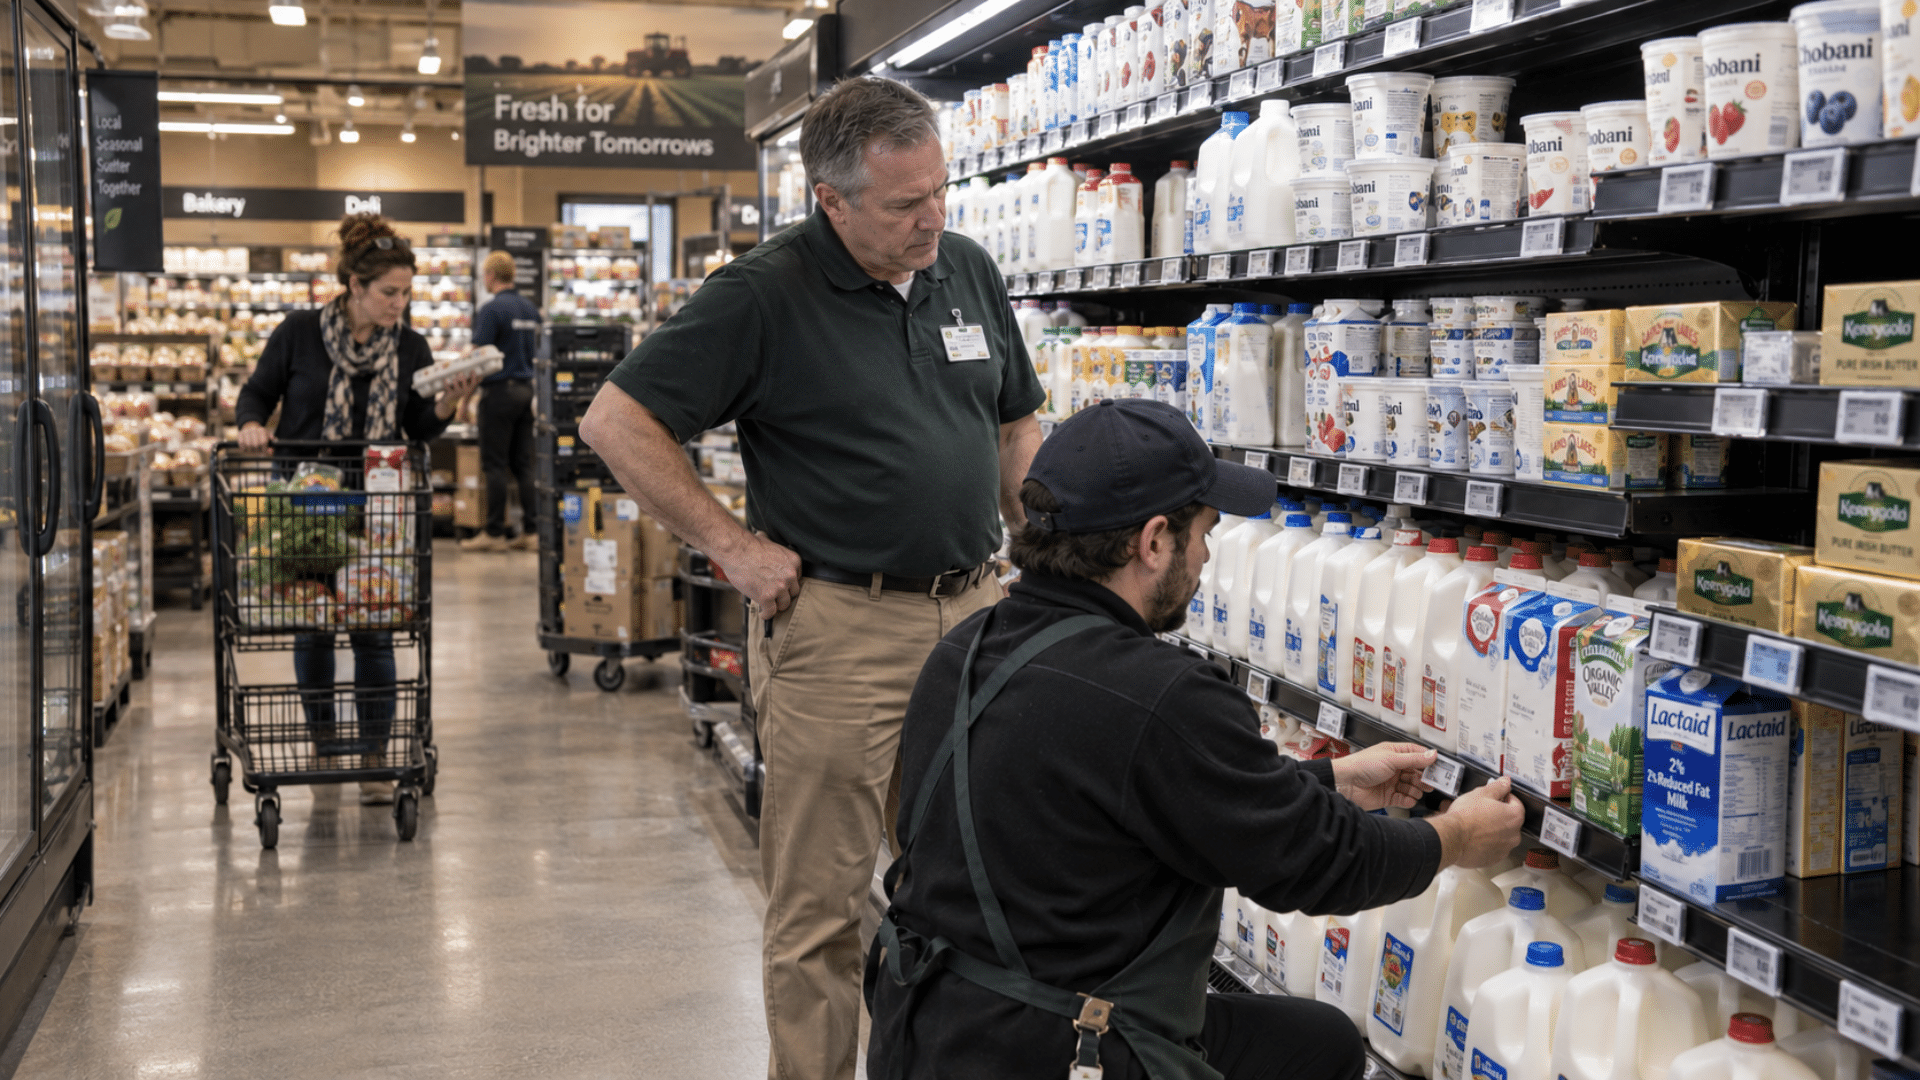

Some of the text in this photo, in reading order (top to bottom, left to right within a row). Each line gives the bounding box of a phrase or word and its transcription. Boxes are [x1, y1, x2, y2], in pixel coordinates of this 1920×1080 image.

[1800, 37, 1873, 66] hobani
[494, 94, 615, 123] Fresh for
[95, 114, 122, 130] Local
[95, 135, 143, 152] Seasonal
[494, 128, 714, 157] Brighter Tomorrows
[97, 179, 142, 198] Together
[182, 191, 246, 218] Bakery
[1836, 359, 1918, 371] PURE IRISH BUTTER
[1832, 536, 1914, 558] PURE IRISH BUTTER
[1582, 665, 1623, 693] ORGANIC
[1587, 682, 1617, 703] VALLEY
[1650, 703, 1711, 738] Lactaid
[1727, 716, 1787, 742] Lactaid
[1669, 757, 1686, 776] 2%
[1657, 771, 1694, 795] Reduced
[1695, 782, 1711, 799] Fat
[1667, 790, 1689, 811] Milk
